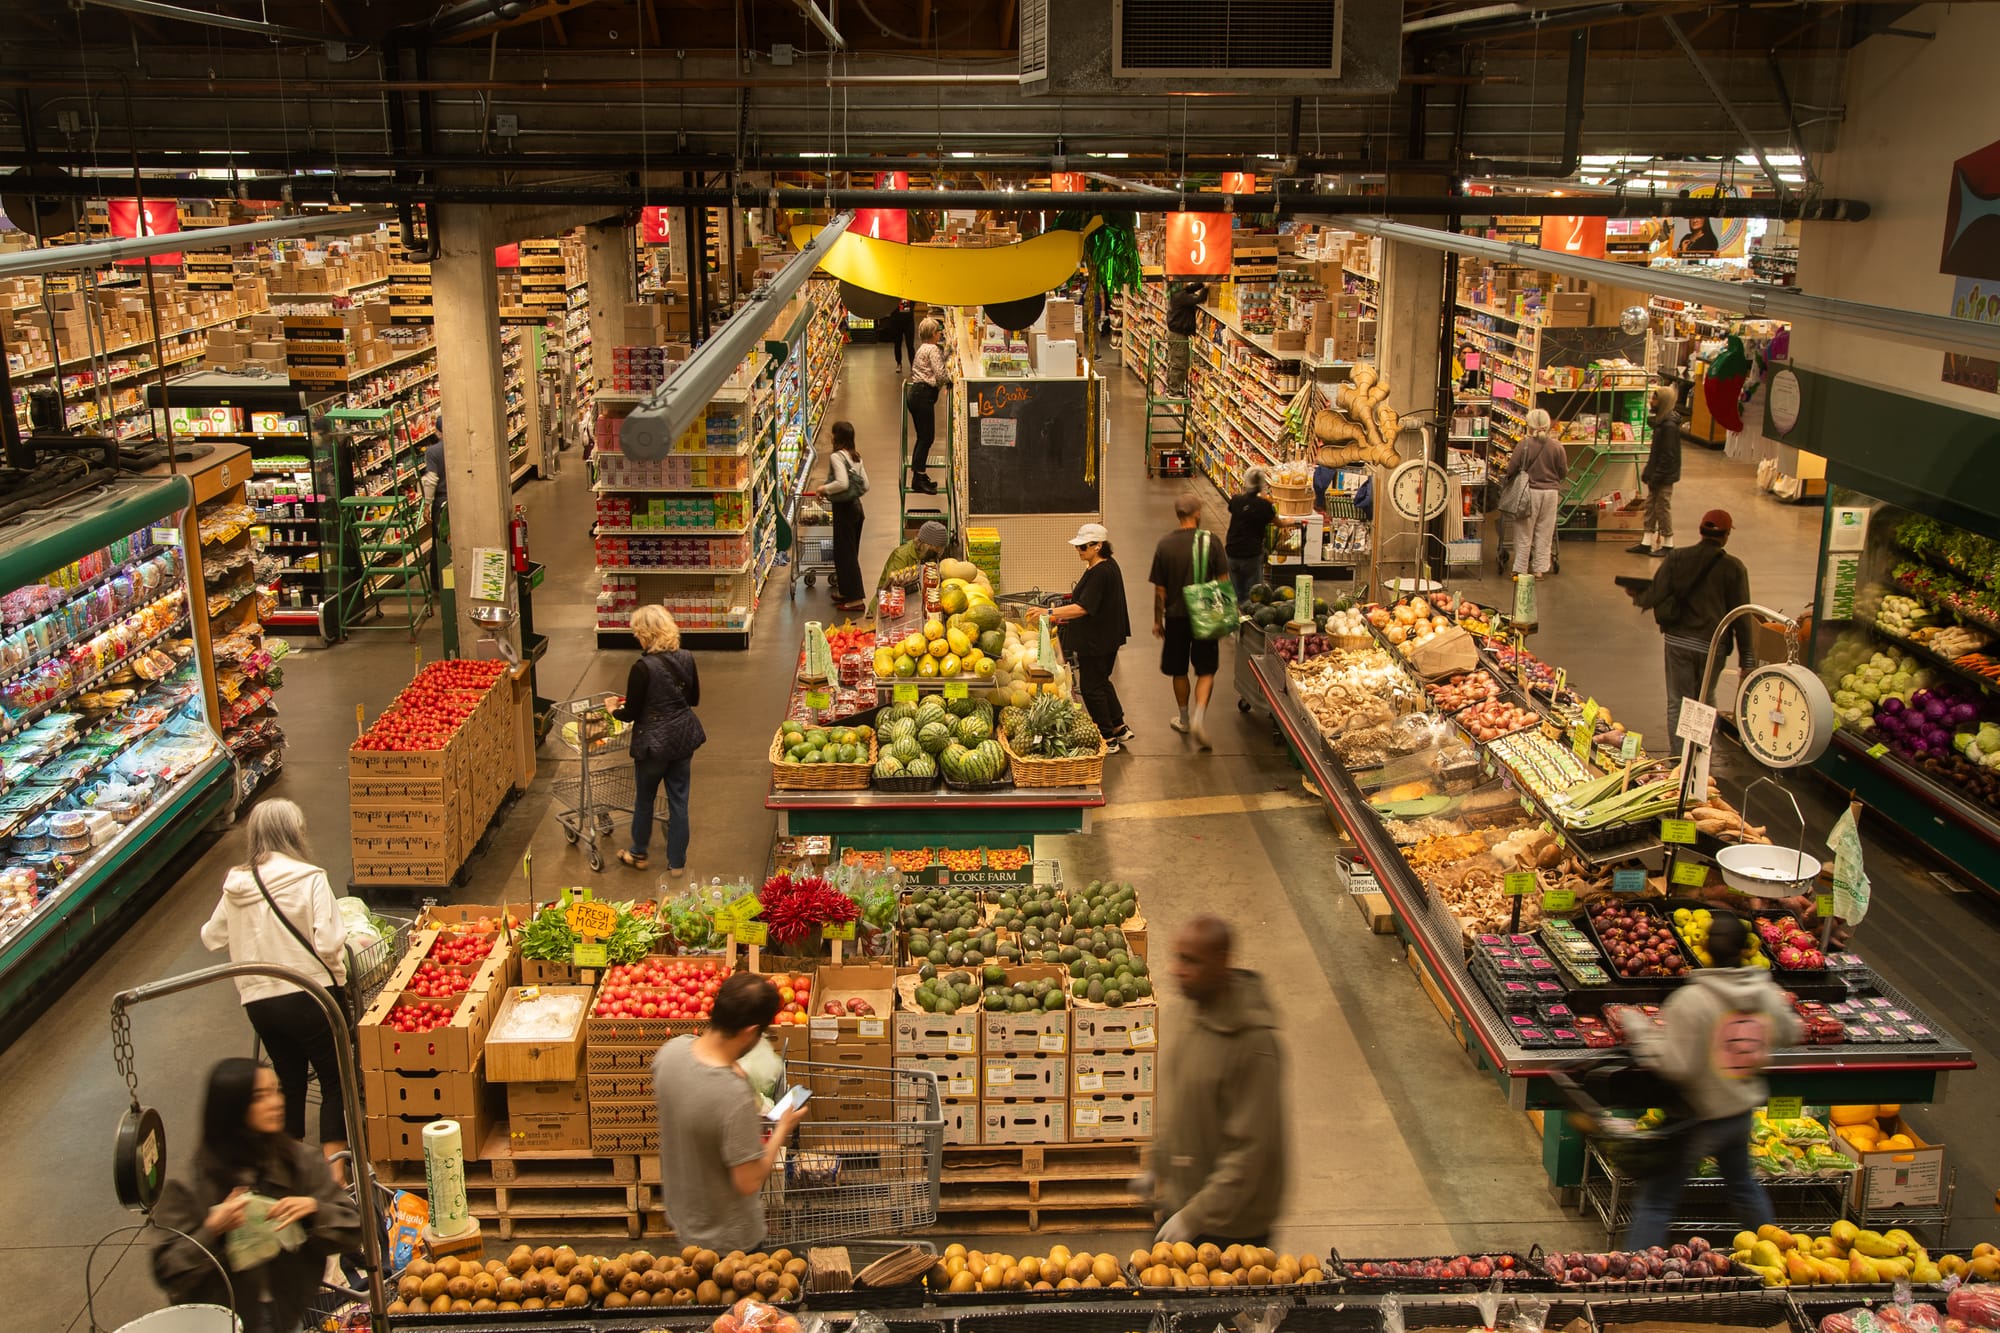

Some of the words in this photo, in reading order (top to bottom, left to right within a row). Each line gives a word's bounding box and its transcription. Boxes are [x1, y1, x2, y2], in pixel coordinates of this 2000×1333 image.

[1234, 172, 1245, 194] 2
[658, 208, 670, 236] 5
[1566, 216, 1584, 250] 2
[1190, 220, 1206, 264] 3
[316, 370, 336, 378] DESSERTS
[978, 391, 994, 416] La
[1765, 682, 1770, 692] 9
[1753, 694, 1758, 704] 8
[1794, 691, 1797, 701] 1
[1752, 714, 1756, 723] 7
[1801, 711, 1806, 721] 2
[1759, 731, 1763, 741] 6
[1798, 730, 1803, 740] 3
[1772, 742, 1777, 751] 5
[1786, 742, 1792, 751] 4
[906, 876, 920, 884] RM
[954, 873, 986, 882] COKE
[988, 872, 1016, 881] FARM
[578, 906, 610, 920] FRESH
[576, 918, 609, 930] MOZZ!
[406, 1212, 424, 1225] gold
